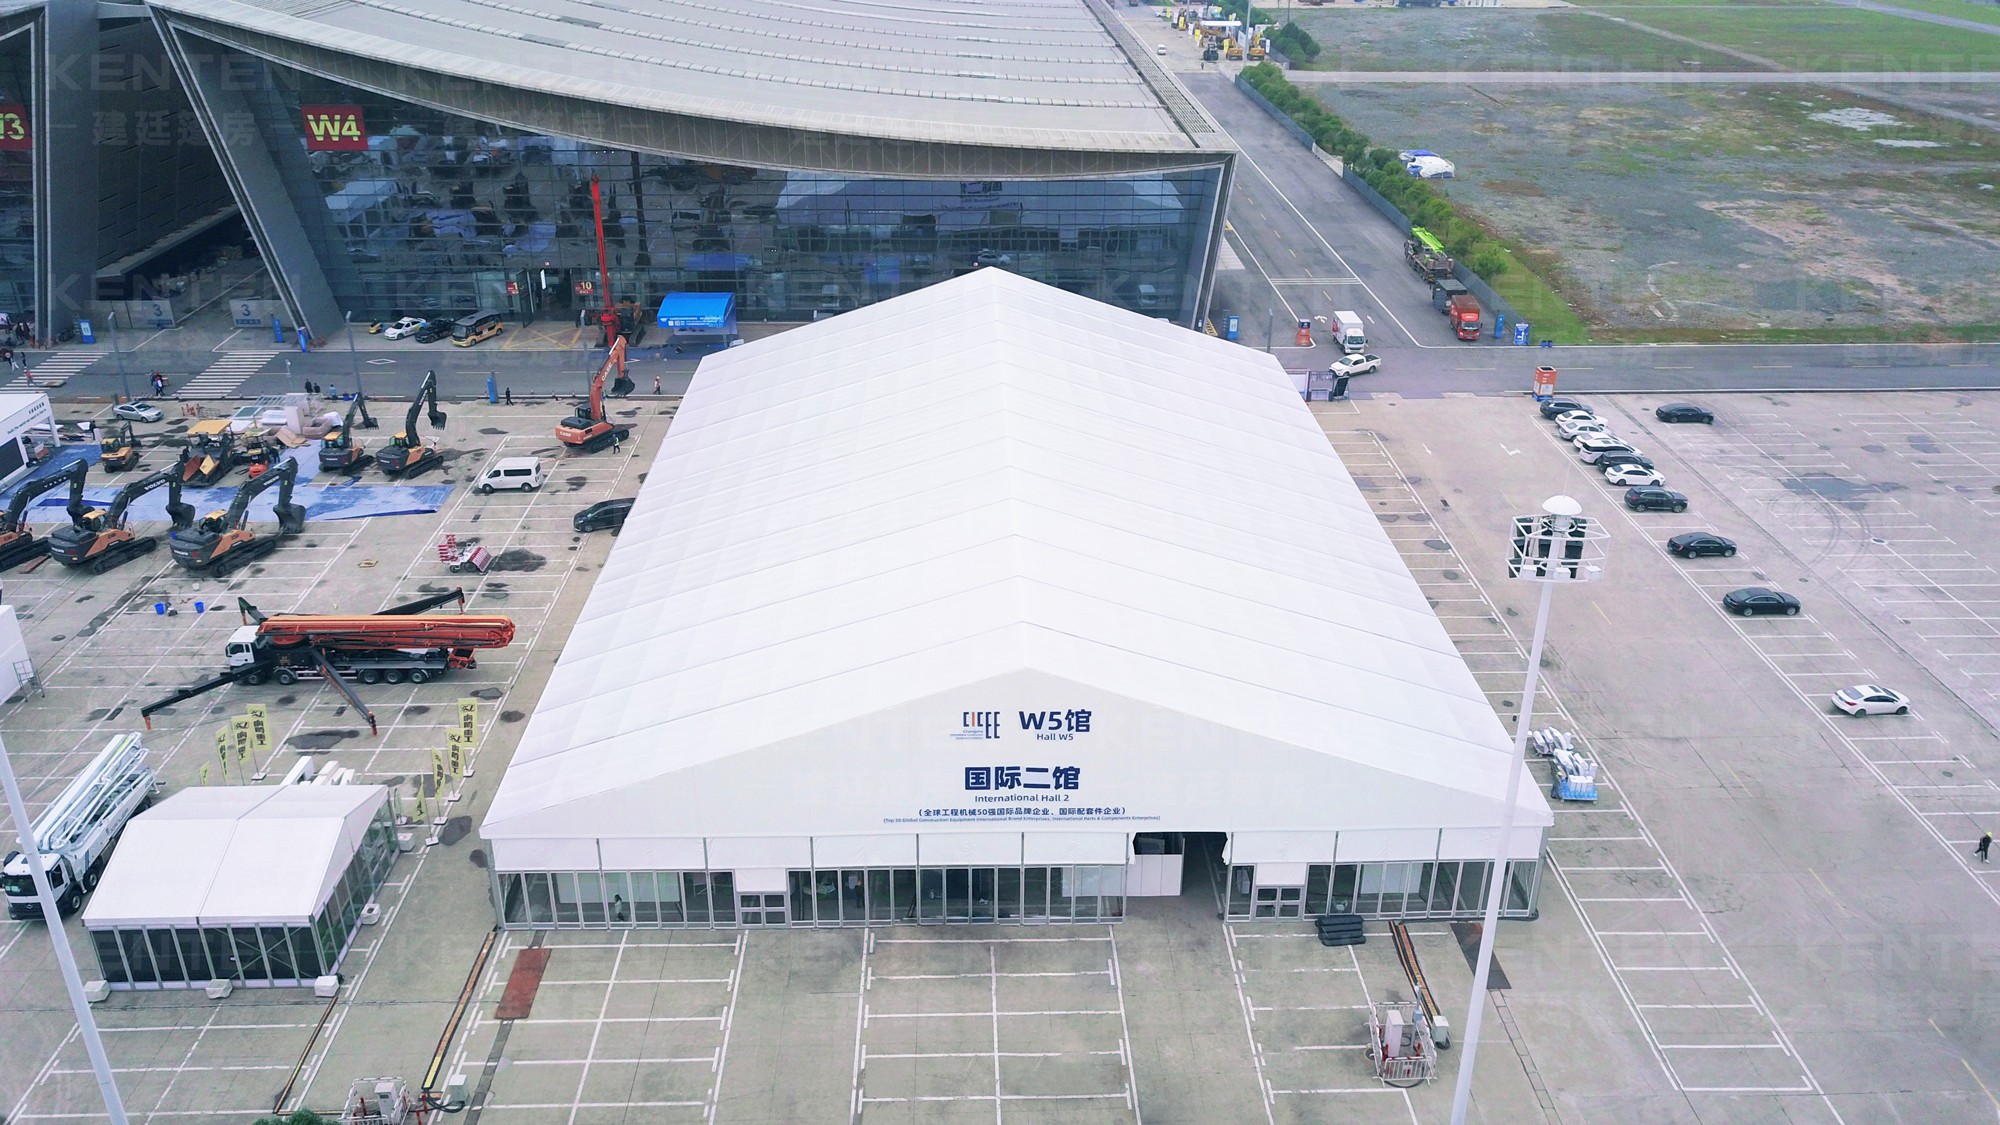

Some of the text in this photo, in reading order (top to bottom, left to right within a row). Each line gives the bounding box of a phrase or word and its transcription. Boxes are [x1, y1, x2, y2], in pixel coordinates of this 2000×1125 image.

[306, 113, 362, 142] W4
[580, 281, 592, 290] 10
[153, 304, 163, 317] 3
[241, 304, 251, 317] 3
[601, 363, 613, 382] CASE
[144, 478, 166, 491] VOLVO
[963, 711, 1000, 739] CICEE
[1018, 708, 1092, 733] W5馆
[1036, 733, 1074, 741] Hall W5
[965, 765, 1081, 790] 国际二馆
[975, 793, 1070, 803] International Hall 2
